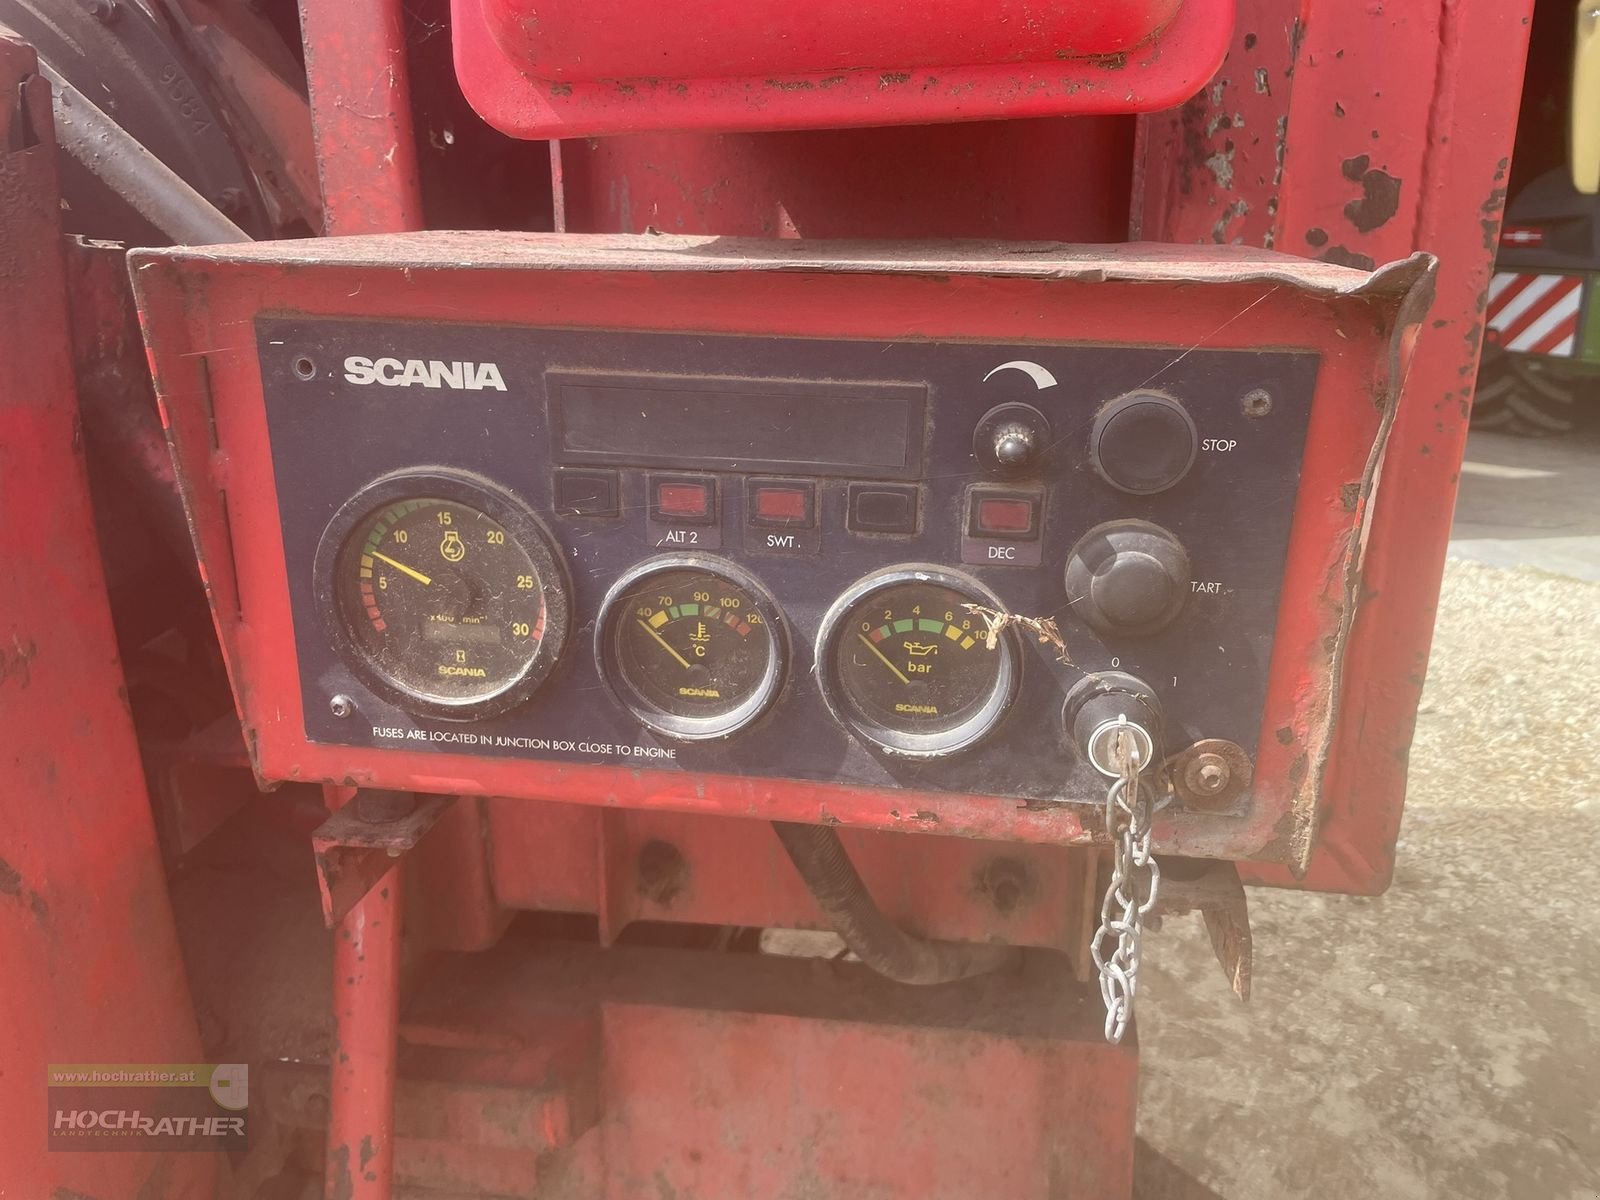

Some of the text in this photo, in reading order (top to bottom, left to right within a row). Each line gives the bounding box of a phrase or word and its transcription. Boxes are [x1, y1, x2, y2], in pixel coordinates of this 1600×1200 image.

[343, 356, 508, 392] SCANIA
[1201, 439, 1238, 452] STOP
[437, 511, 452, 526] 15
[393, 530, 408, 543] 10
[487, 531, 504, 545] 20
[665, 530, 698, 544] ALT 2
[766, 535, 795, 549] SWT
[988, 546, 1016, 560] DEC
[379, 578, 388, 590] 5
[516, 576, 534, 589] 25
[1190, 581, 1222, 594] TART
[658, 595, 673, 607] 70
[693, 591, 710, 602] 90
[719, 597, 740, 609] 100
[636, 607, 652, 617] 40
[884, 610, 893, 620] 2
[912, 605, 921, 616] 4
[944, 611, 954, 622] 6
[512, 622, 529, 636] 30
[861, 622, 871, 633] 0
[962, 620, 971, 630] 8
[974, 630, 988, 640] 10
[907, 660, 932, 673] bar
[1111, 657, 1120, 668] 0
[438, 665, 486, 678] SCANIA
[679, 686, 720, 698] SCANIA
[895, 703, 938, 714] SCANIA
[372, 726, 677, 759] FUSES ARE LOCATED IN JUNCTION BOX CLOSE TO ENGINE
